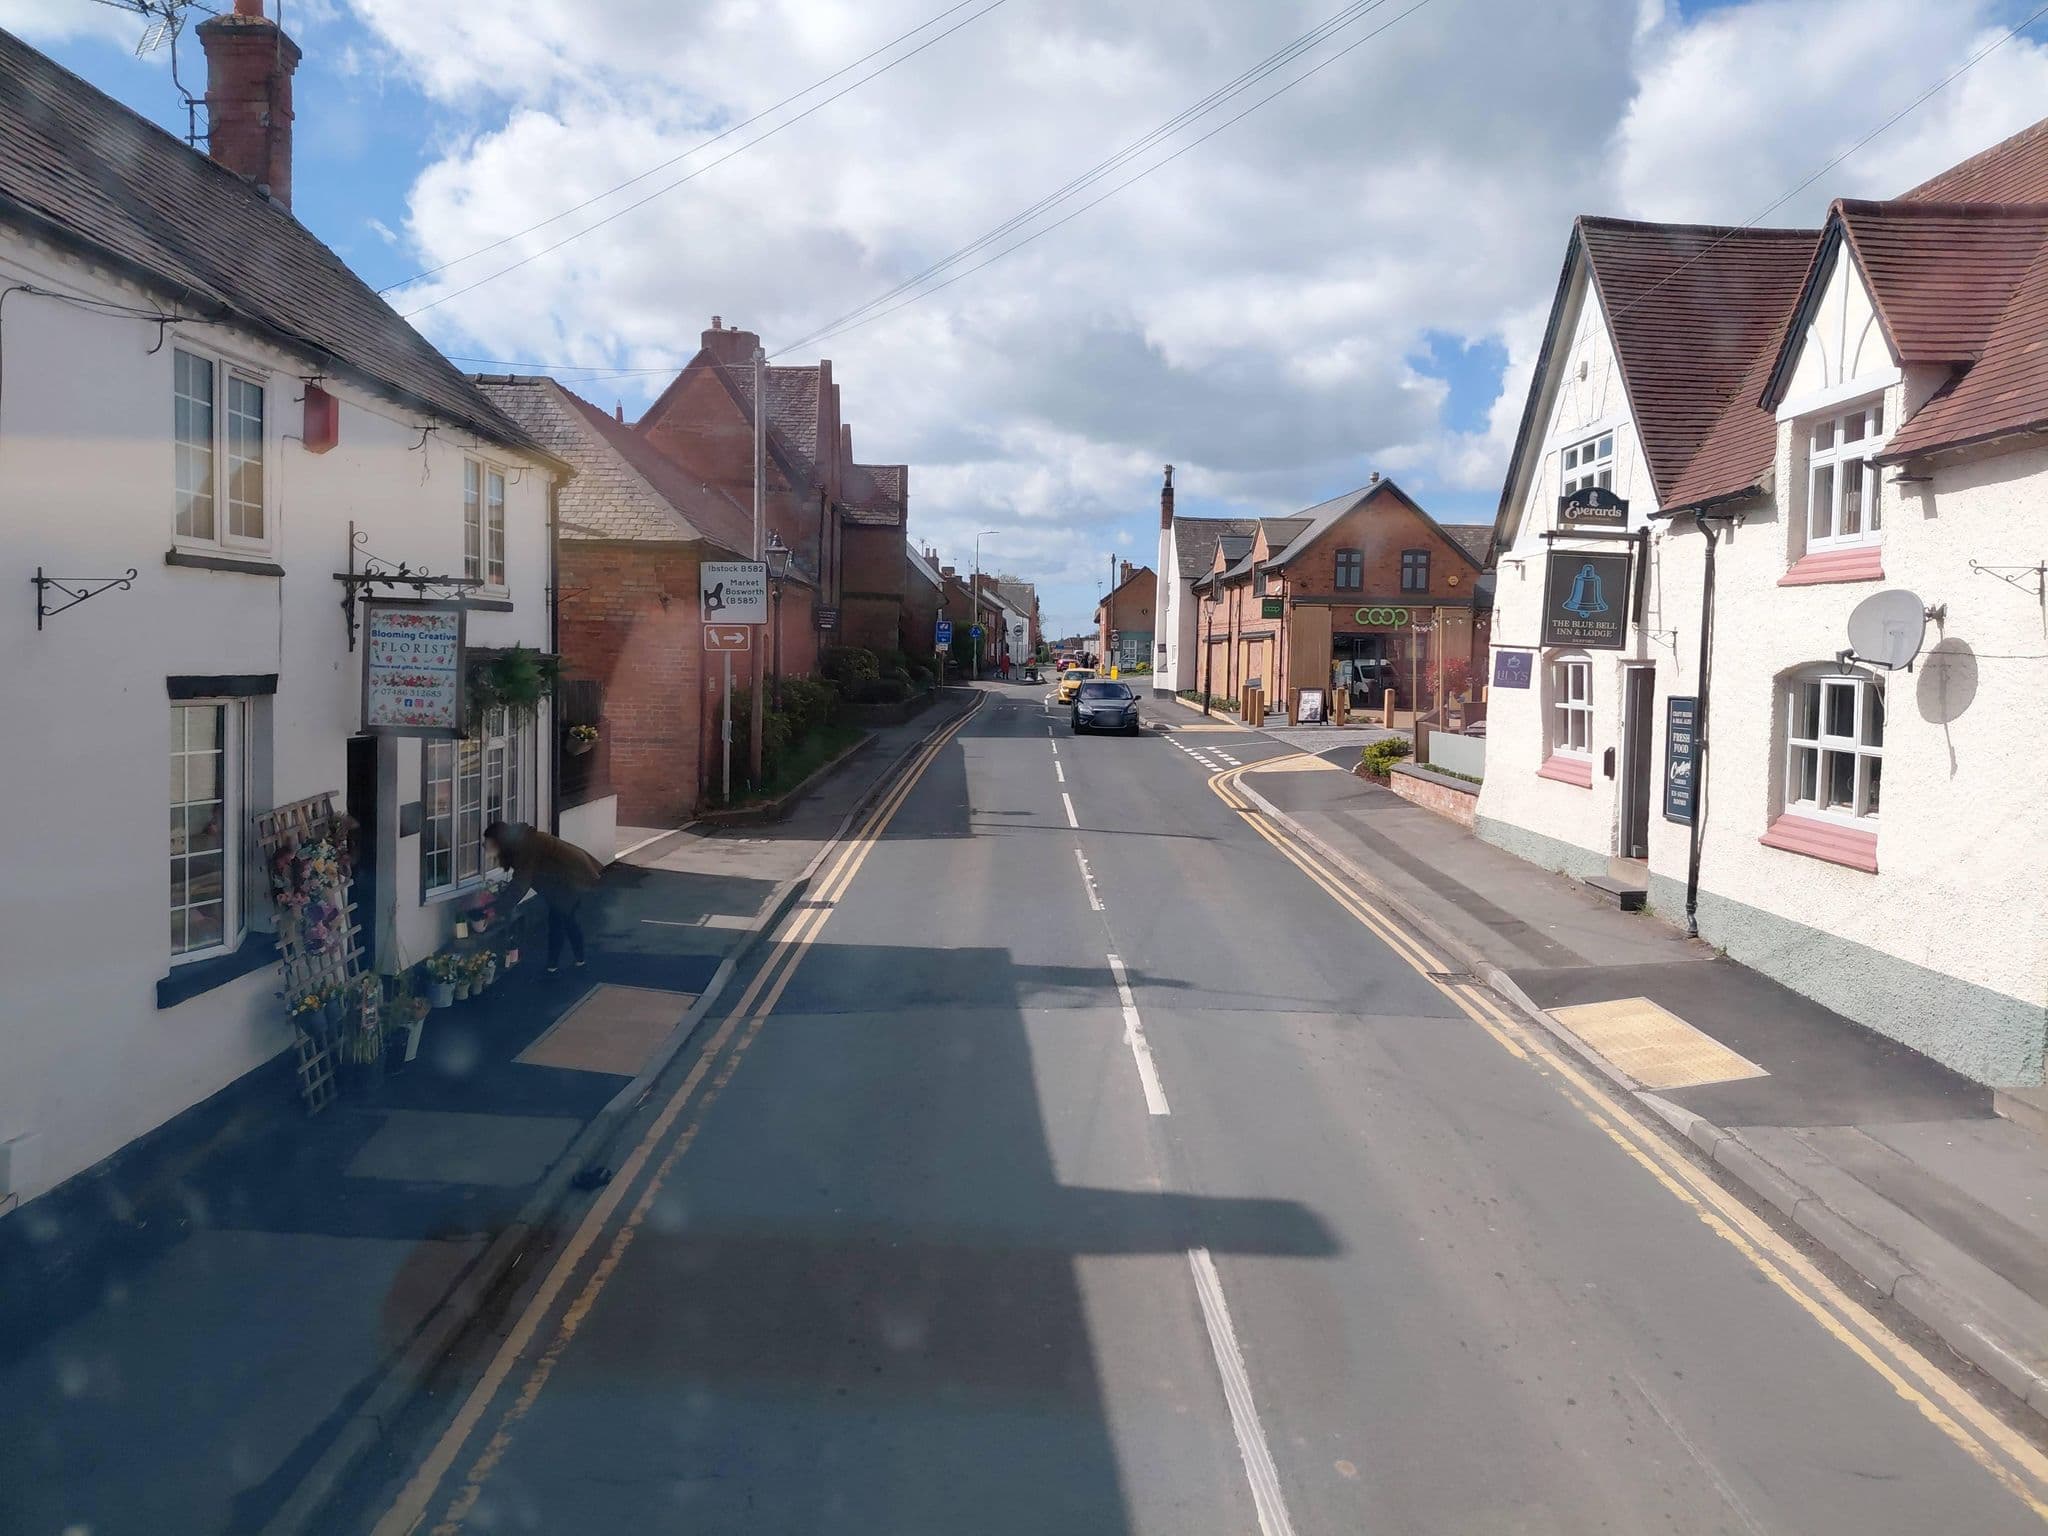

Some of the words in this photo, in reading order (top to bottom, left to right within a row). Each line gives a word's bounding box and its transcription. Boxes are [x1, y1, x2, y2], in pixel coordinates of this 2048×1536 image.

[1565, 501, 1622, 518] Everards
[730, 579, 759, 587] Market
[1552, 619, 1570, 627] THE
[1572, 621, 1594, 629] BLUE
[1595, 622, 1617, 630] BELL
[371, 629, 416, 641] Blooming
[418, 631, 457, 641] Creative
[1583, 629, 1613, 638] LODGE
[381, 641, 449, 655] FLORIST
[1673, 733, 1691, 743] FRESH
[1673, 743, 1689, 754] FOOD
